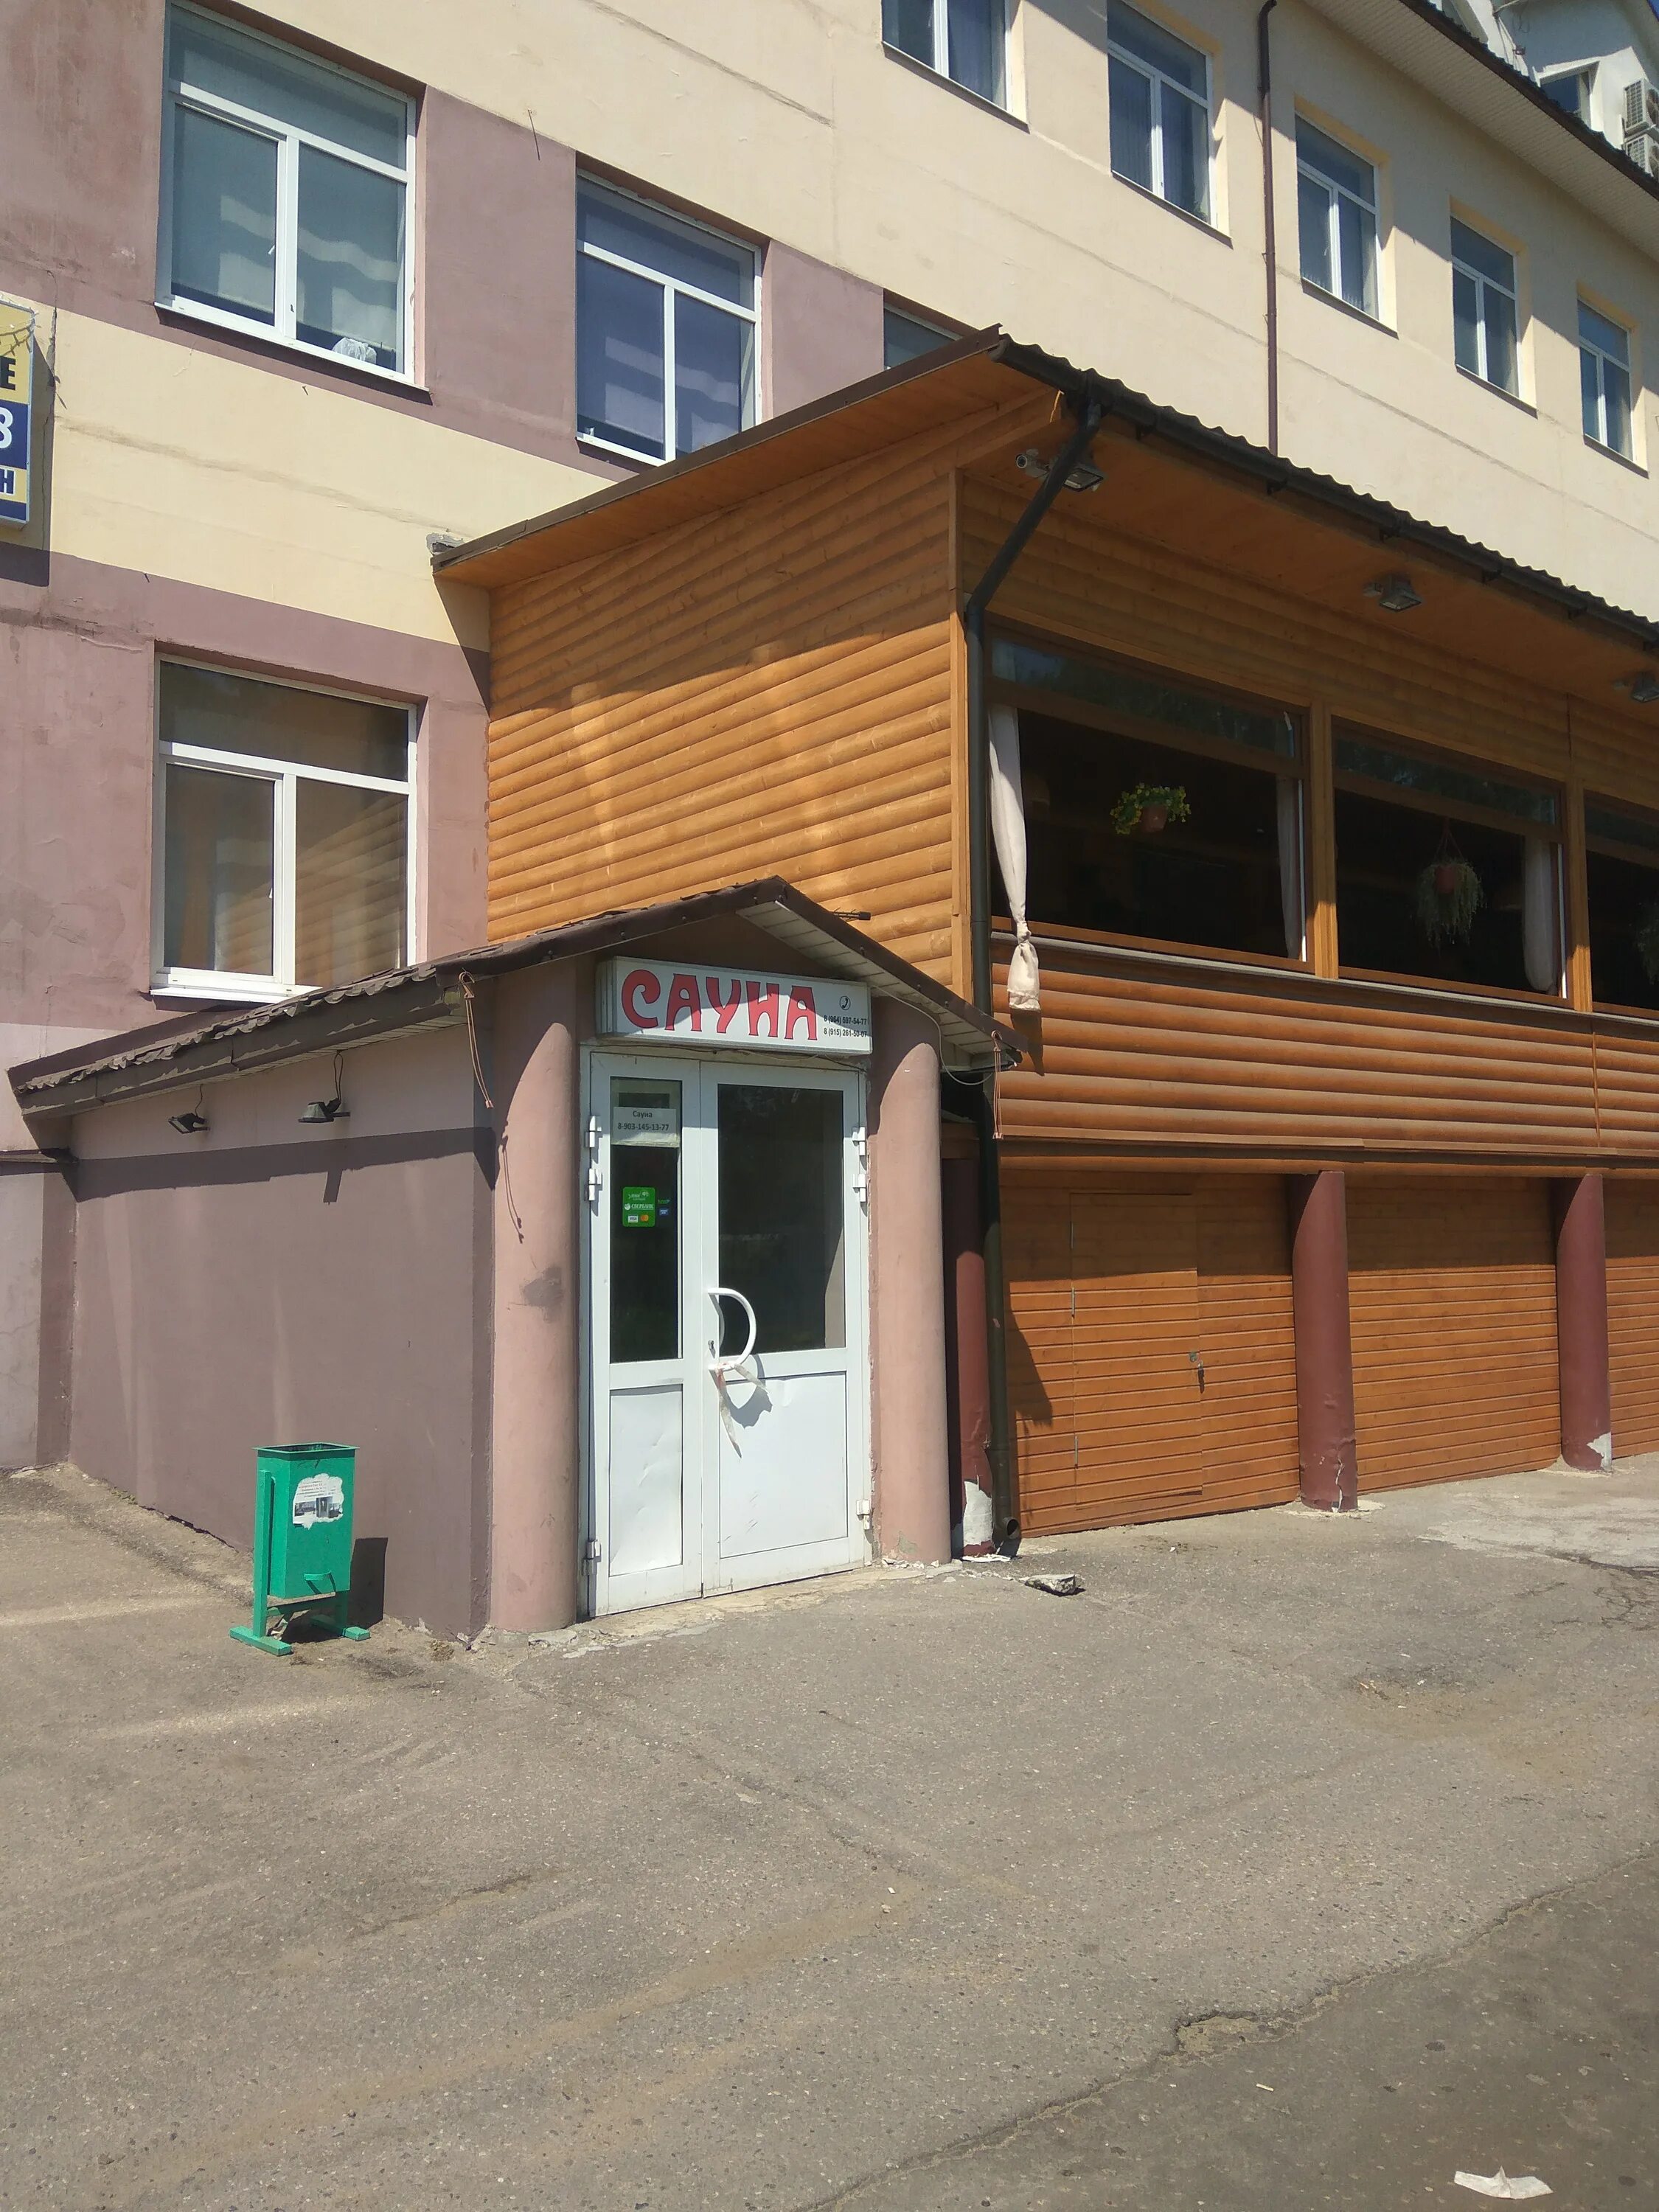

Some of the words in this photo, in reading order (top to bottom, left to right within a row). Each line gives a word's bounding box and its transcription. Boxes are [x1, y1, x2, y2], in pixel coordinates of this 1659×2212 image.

[622, 970, 818, 1040] САУНА
[828, 1028, 841, 1037] (915)
[842, 1029, 867, 1037] 261-50-07
[633, 1110, 653, 1119] Сауна
[617, 1122, 669, 1131] 8-903-145-13-77
